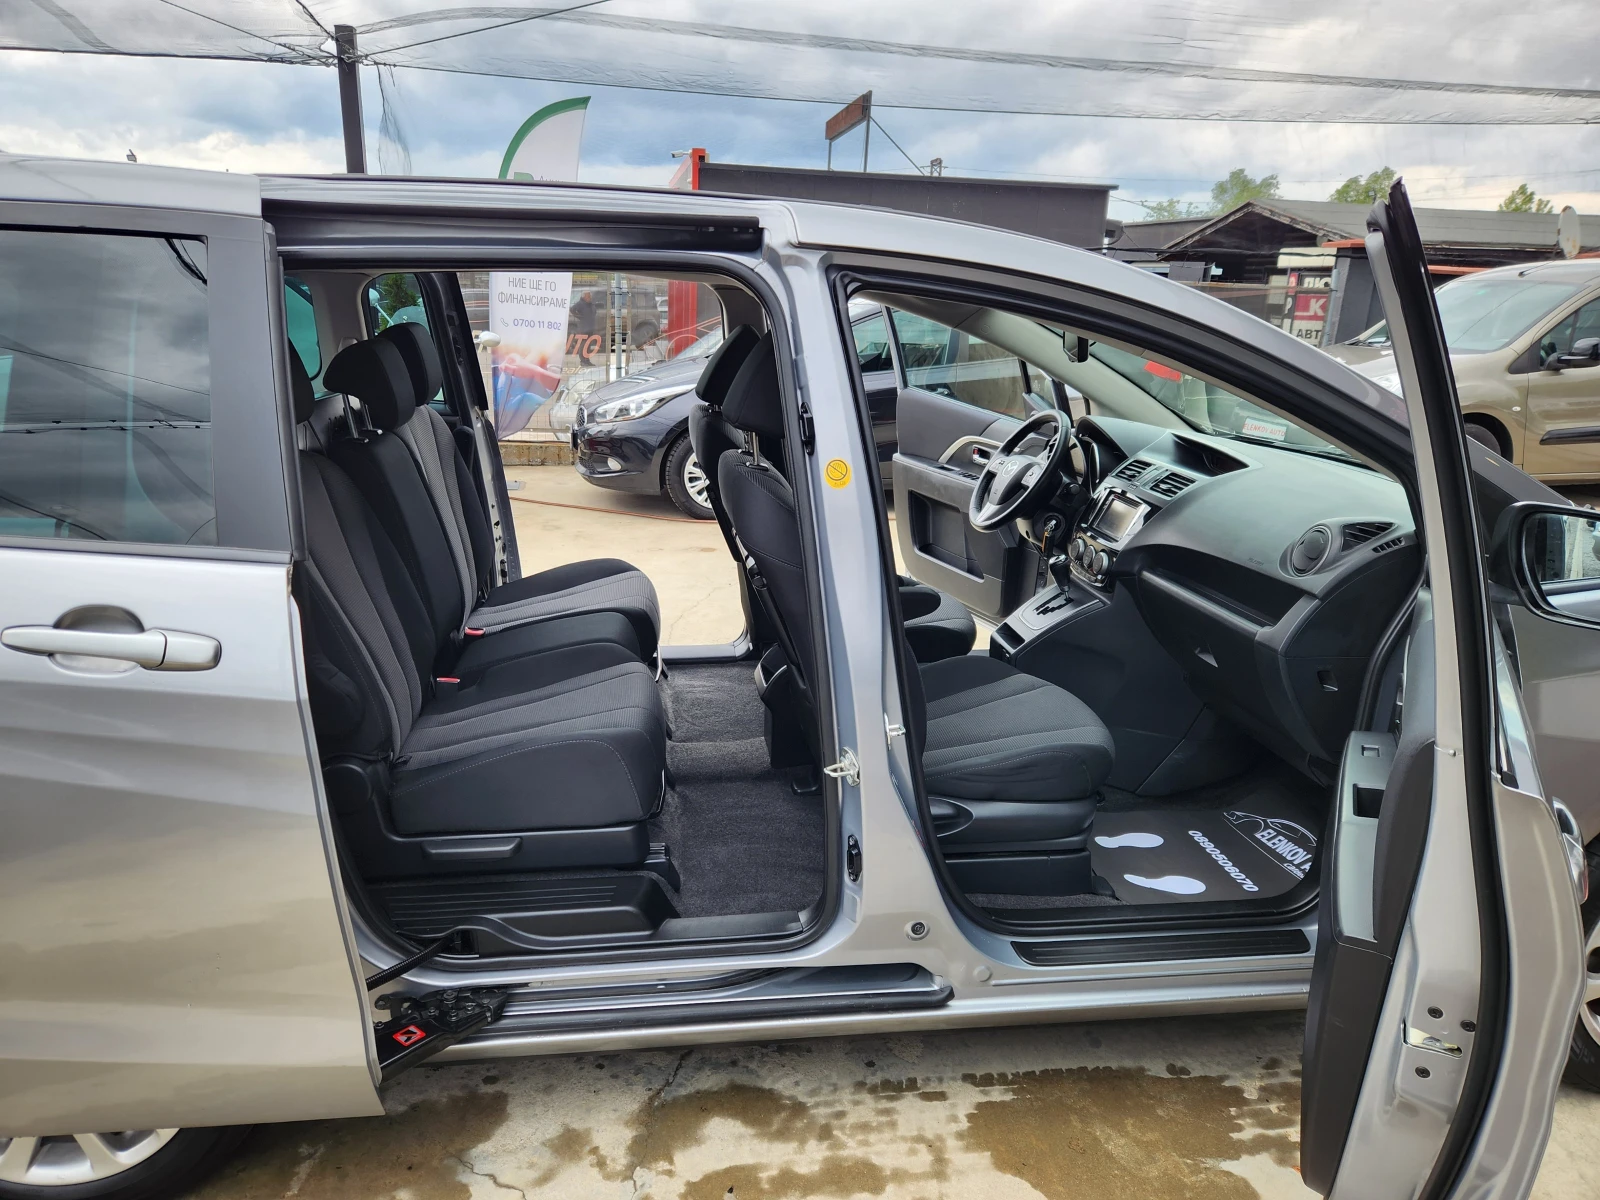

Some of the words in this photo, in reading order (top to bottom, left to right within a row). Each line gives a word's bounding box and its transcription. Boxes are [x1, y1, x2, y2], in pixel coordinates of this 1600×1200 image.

[508, 277, 527, 289] НИЕ
[529, 279, 543, 292] ЩЕ
[544, 281, 557, 292] ГО
[497, 291, 568, 309] ФИНАНСИРАМЕ
[513, 318, 536, 329] 0700
[537, 320, 545, 329] 11
[547, 321, 562, 331] 802
[1296, 328, 1322, 339] АВТ
[561, 365, 592, 375] ealer
[1269, 427, 1286, 437] AUTO
[1253, 828, 1313, 865] ELENKOV
[1188, 830, 1259, 892] 0890506070
